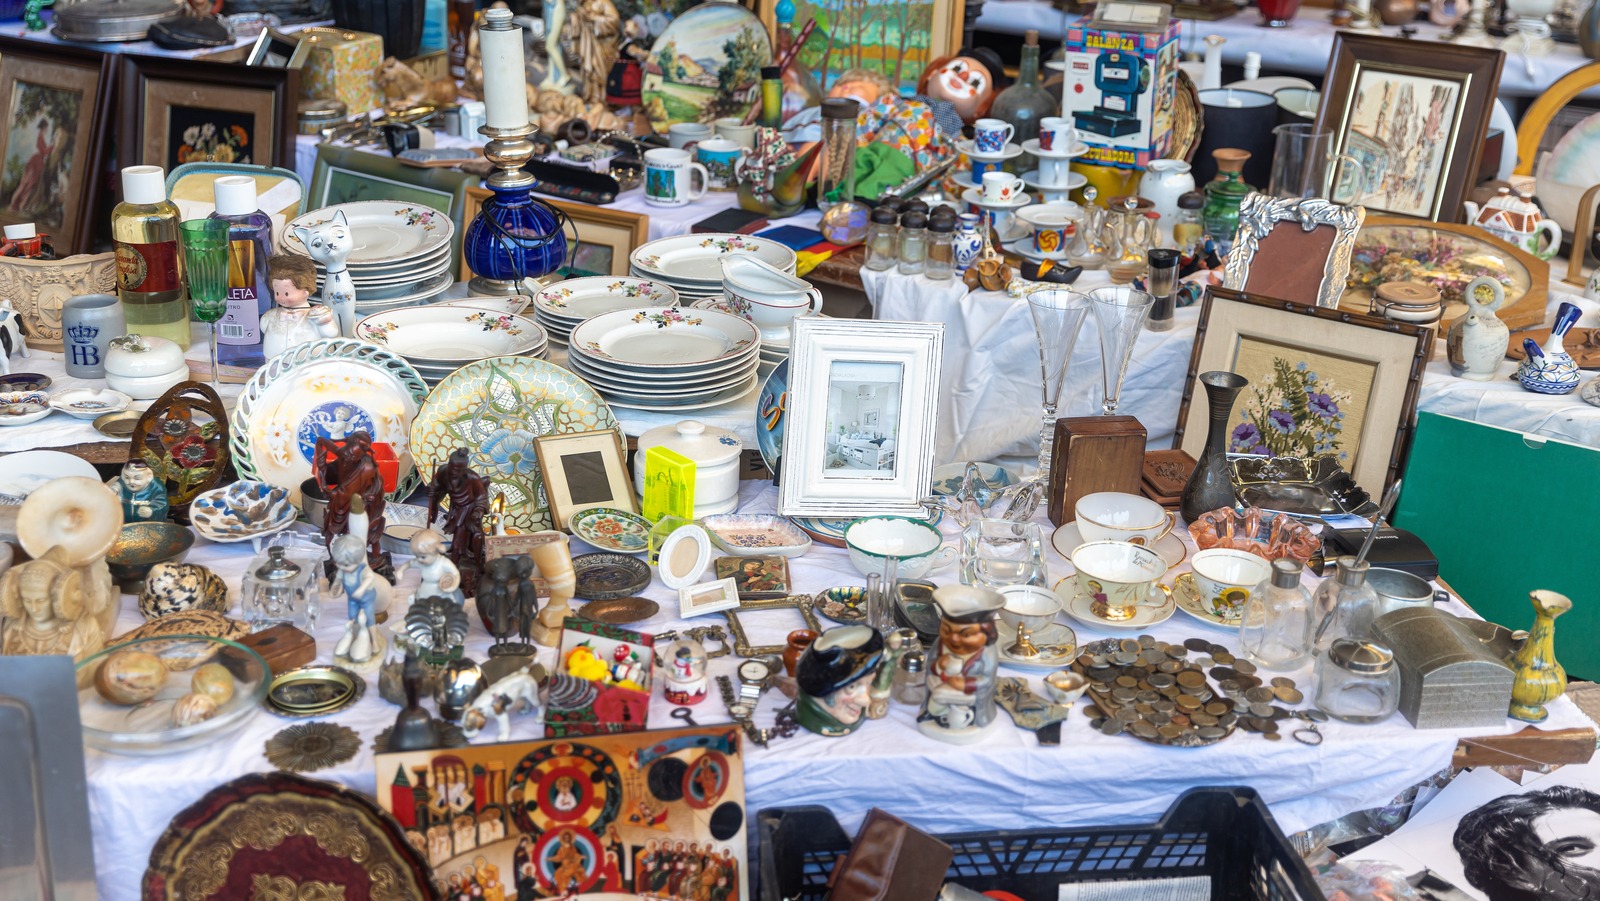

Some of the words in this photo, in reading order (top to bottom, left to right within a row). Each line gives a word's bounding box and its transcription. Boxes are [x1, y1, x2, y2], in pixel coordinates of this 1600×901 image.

[1087, 35, 1135, 51] BALANZA
[1082, 148, 1136, 164] CULADORA
[227, 288, 255, 300] LETA
[71, 344, 100, 366] HB
